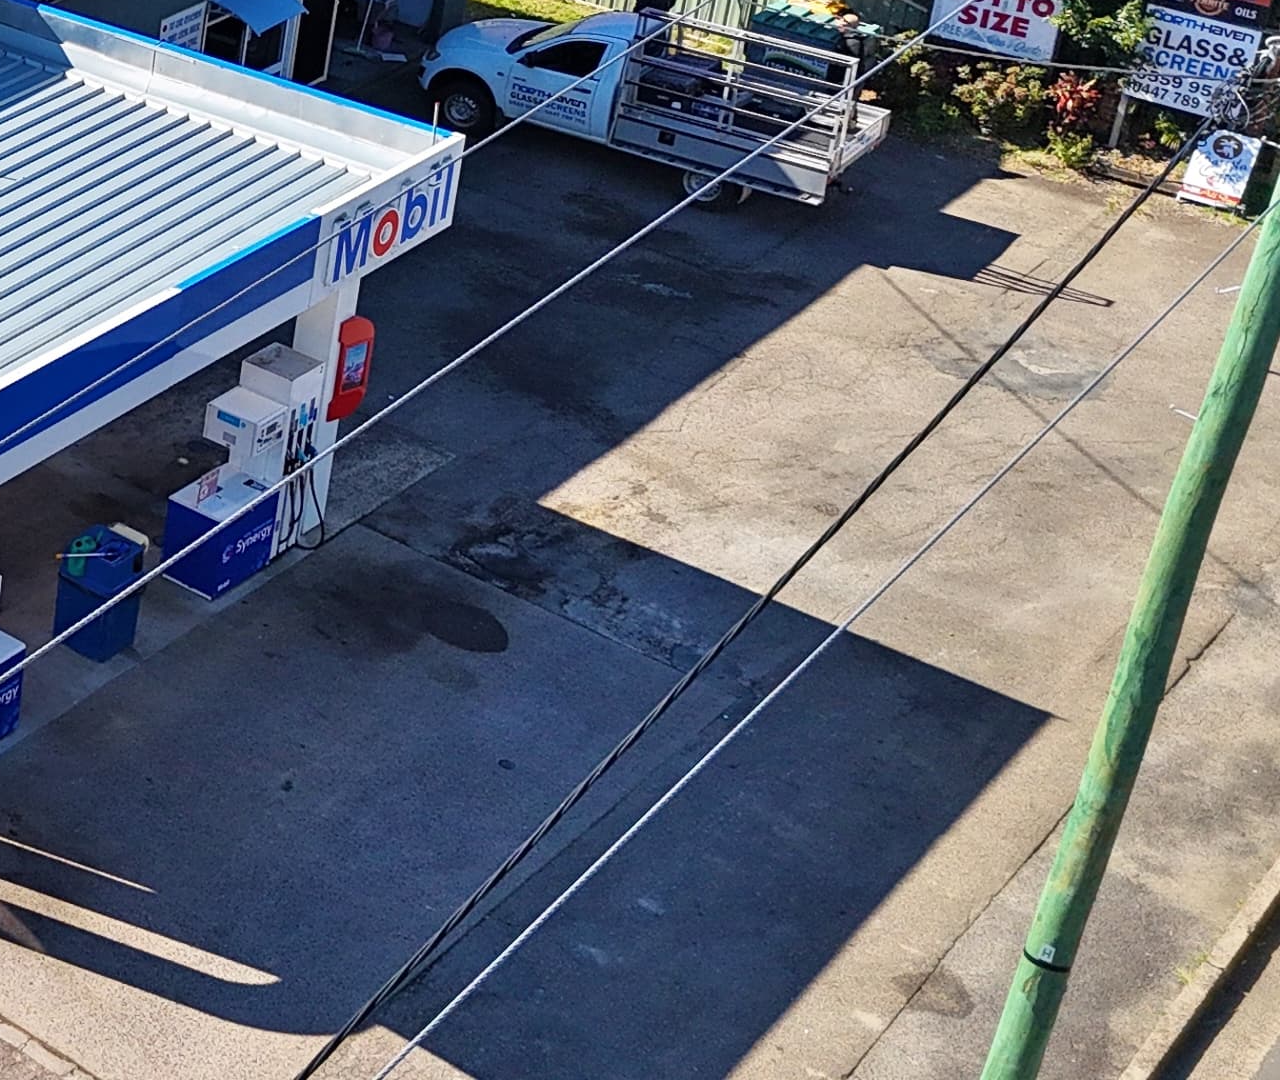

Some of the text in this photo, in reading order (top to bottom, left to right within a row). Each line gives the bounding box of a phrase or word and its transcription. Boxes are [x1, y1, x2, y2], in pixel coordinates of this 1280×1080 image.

[957, 5, 1030, 38] SIZE
[1235, 6, 1258, 19] OILS
[1174, 92, 1200, 109] 789
[332, 160, 455, 284] Mobil
[235, 523, 273, 555] Synergy
